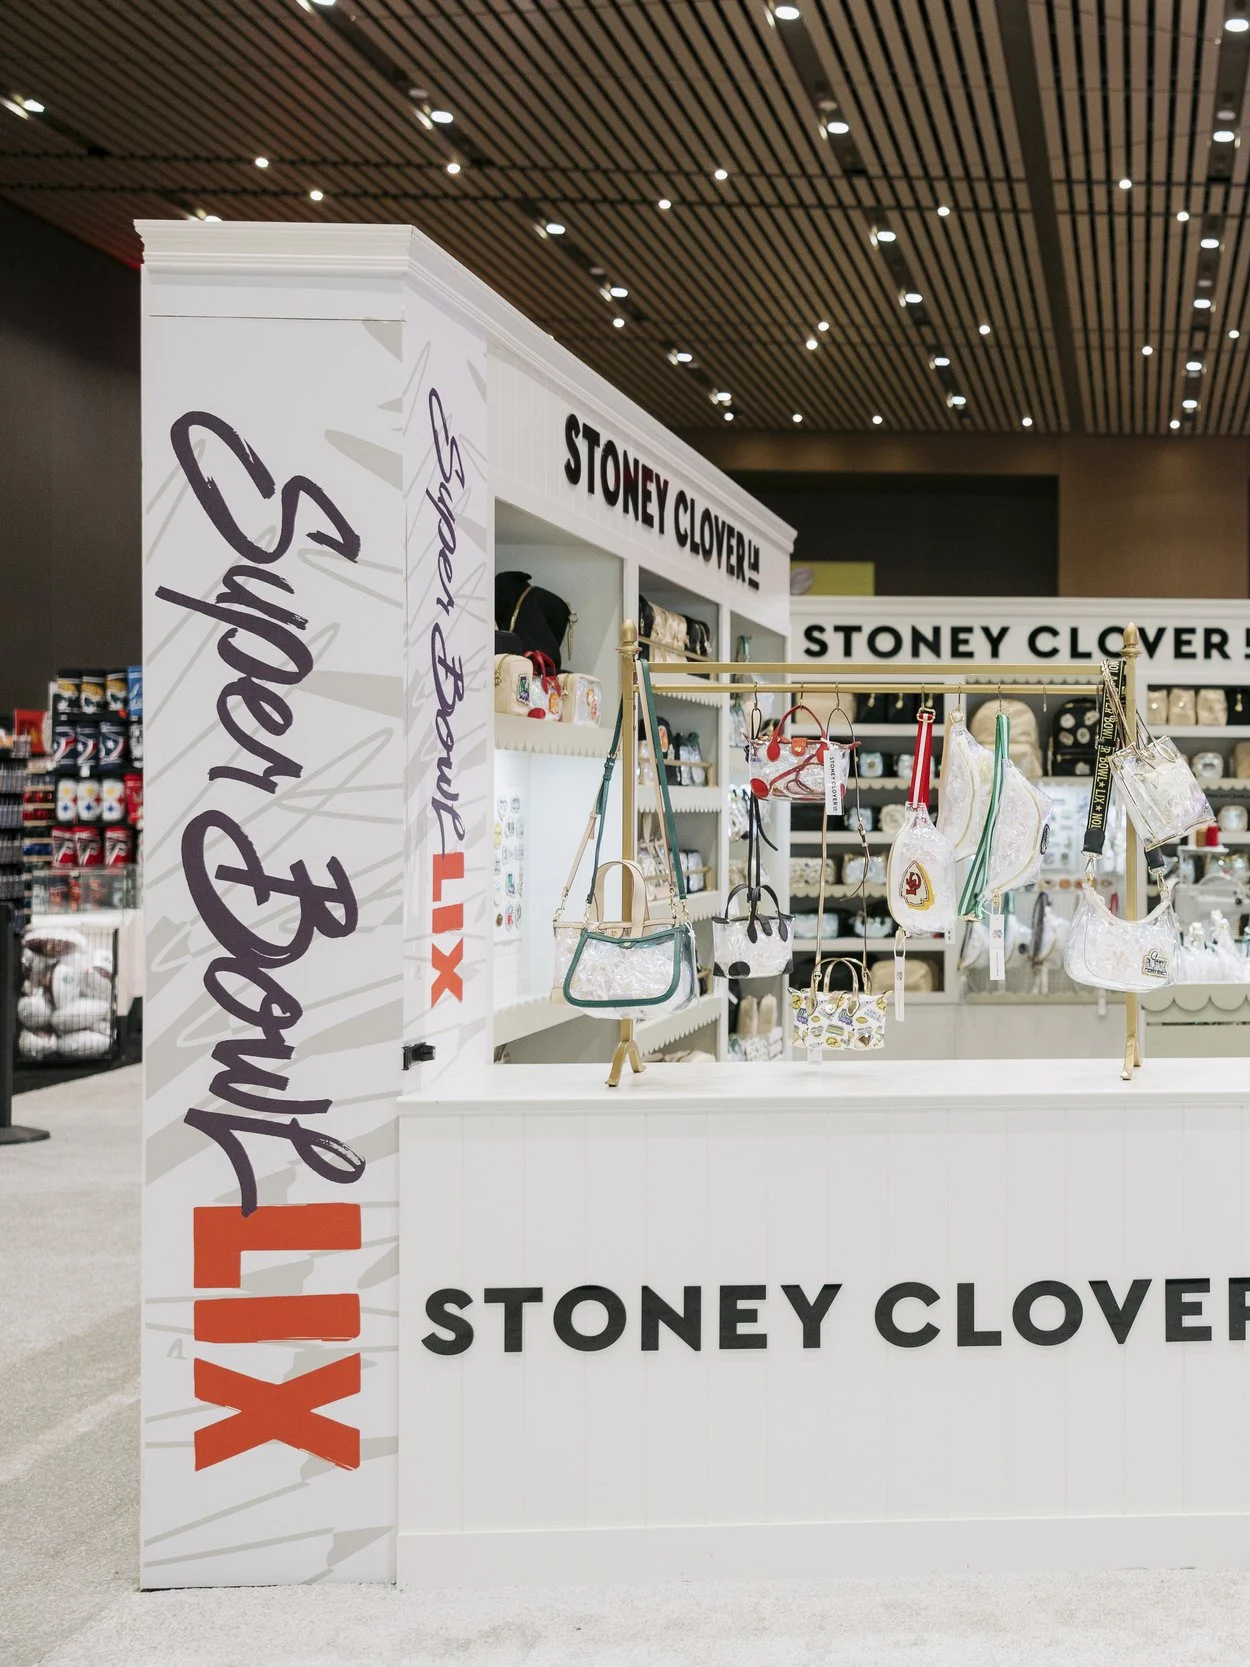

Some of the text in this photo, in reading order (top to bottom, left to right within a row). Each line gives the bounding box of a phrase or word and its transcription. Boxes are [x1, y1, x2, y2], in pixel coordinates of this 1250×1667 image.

[564, 413, 669, 535] STONEY
[674, 489, 746, 584] CLOVER
[803, 624, 1010, 659] STONEY
[1027, 625, 1231, 660] CLOVER
[425, 387, 465, 1008] Super Bowl LIX
[1093, 788, 1106, 804] LIX
[1096, 757, 1109, 783] BOWL
[155, 411, 366, 1472] Super Bowl LIX
[421, 1283, 843, 1356] STONEY
